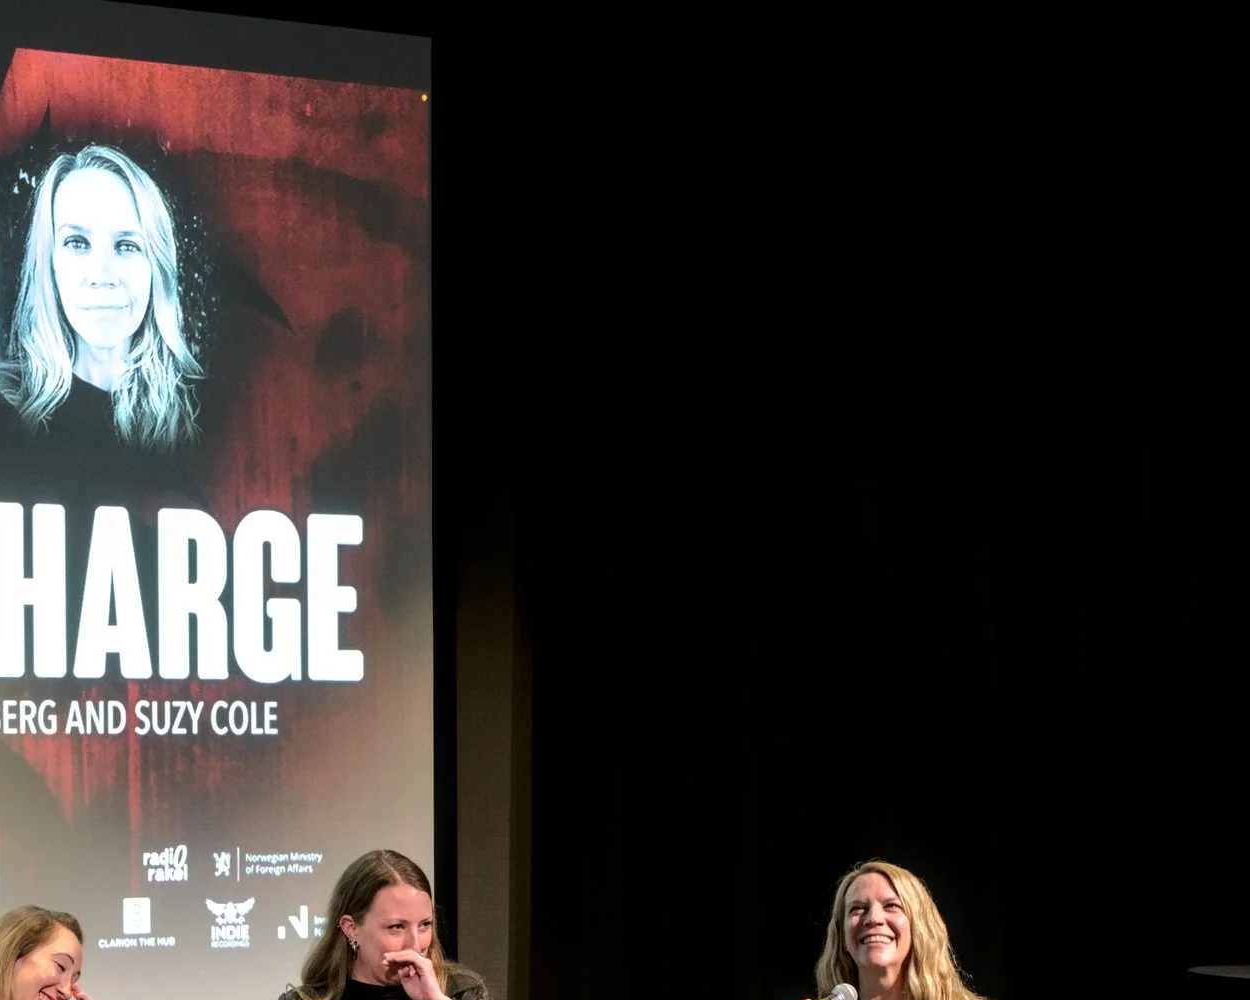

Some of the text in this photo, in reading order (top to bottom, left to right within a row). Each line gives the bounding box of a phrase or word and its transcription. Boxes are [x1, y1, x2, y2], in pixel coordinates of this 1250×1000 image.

[65, 701, 126, 735] AND
[135, 700, 203, 735] SUZY
[211, 701, 278, 735] COLE
[246, 852, 323, 865] Norwegian Ministry
[148, 863, 188, 881] rakel
[246, 863, 314, 876] of Foreign Affairs
[211, 924, 250, 940] INDIE
[139, 937, 155, 947] THE
